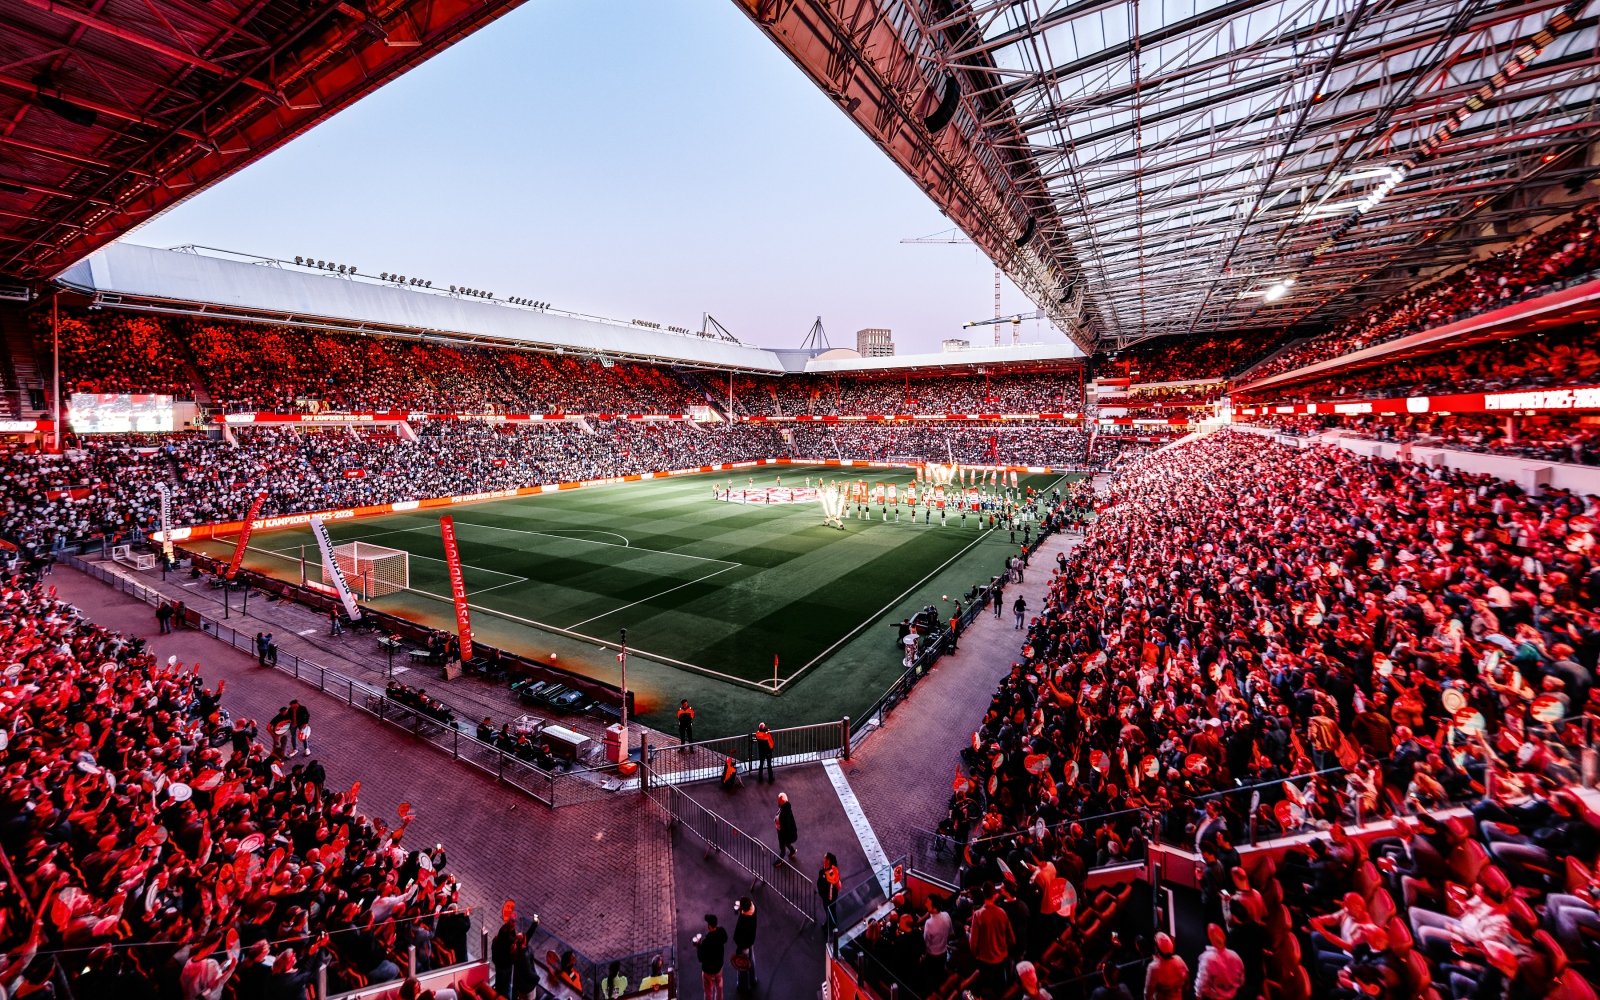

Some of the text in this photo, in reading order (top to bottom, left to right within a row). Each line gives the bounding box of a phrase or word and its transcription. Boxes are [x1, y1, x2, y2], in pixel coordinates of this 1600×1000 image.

[451, 495, 463, 503] PSV
[463, 492, 490, 502] KAMPIOEN
[252, 520, 264, 529] SV
[265, 514, 311, 528] KAMPIOEN
[442, 524, 469, 624] PSV EINDHOVEN
